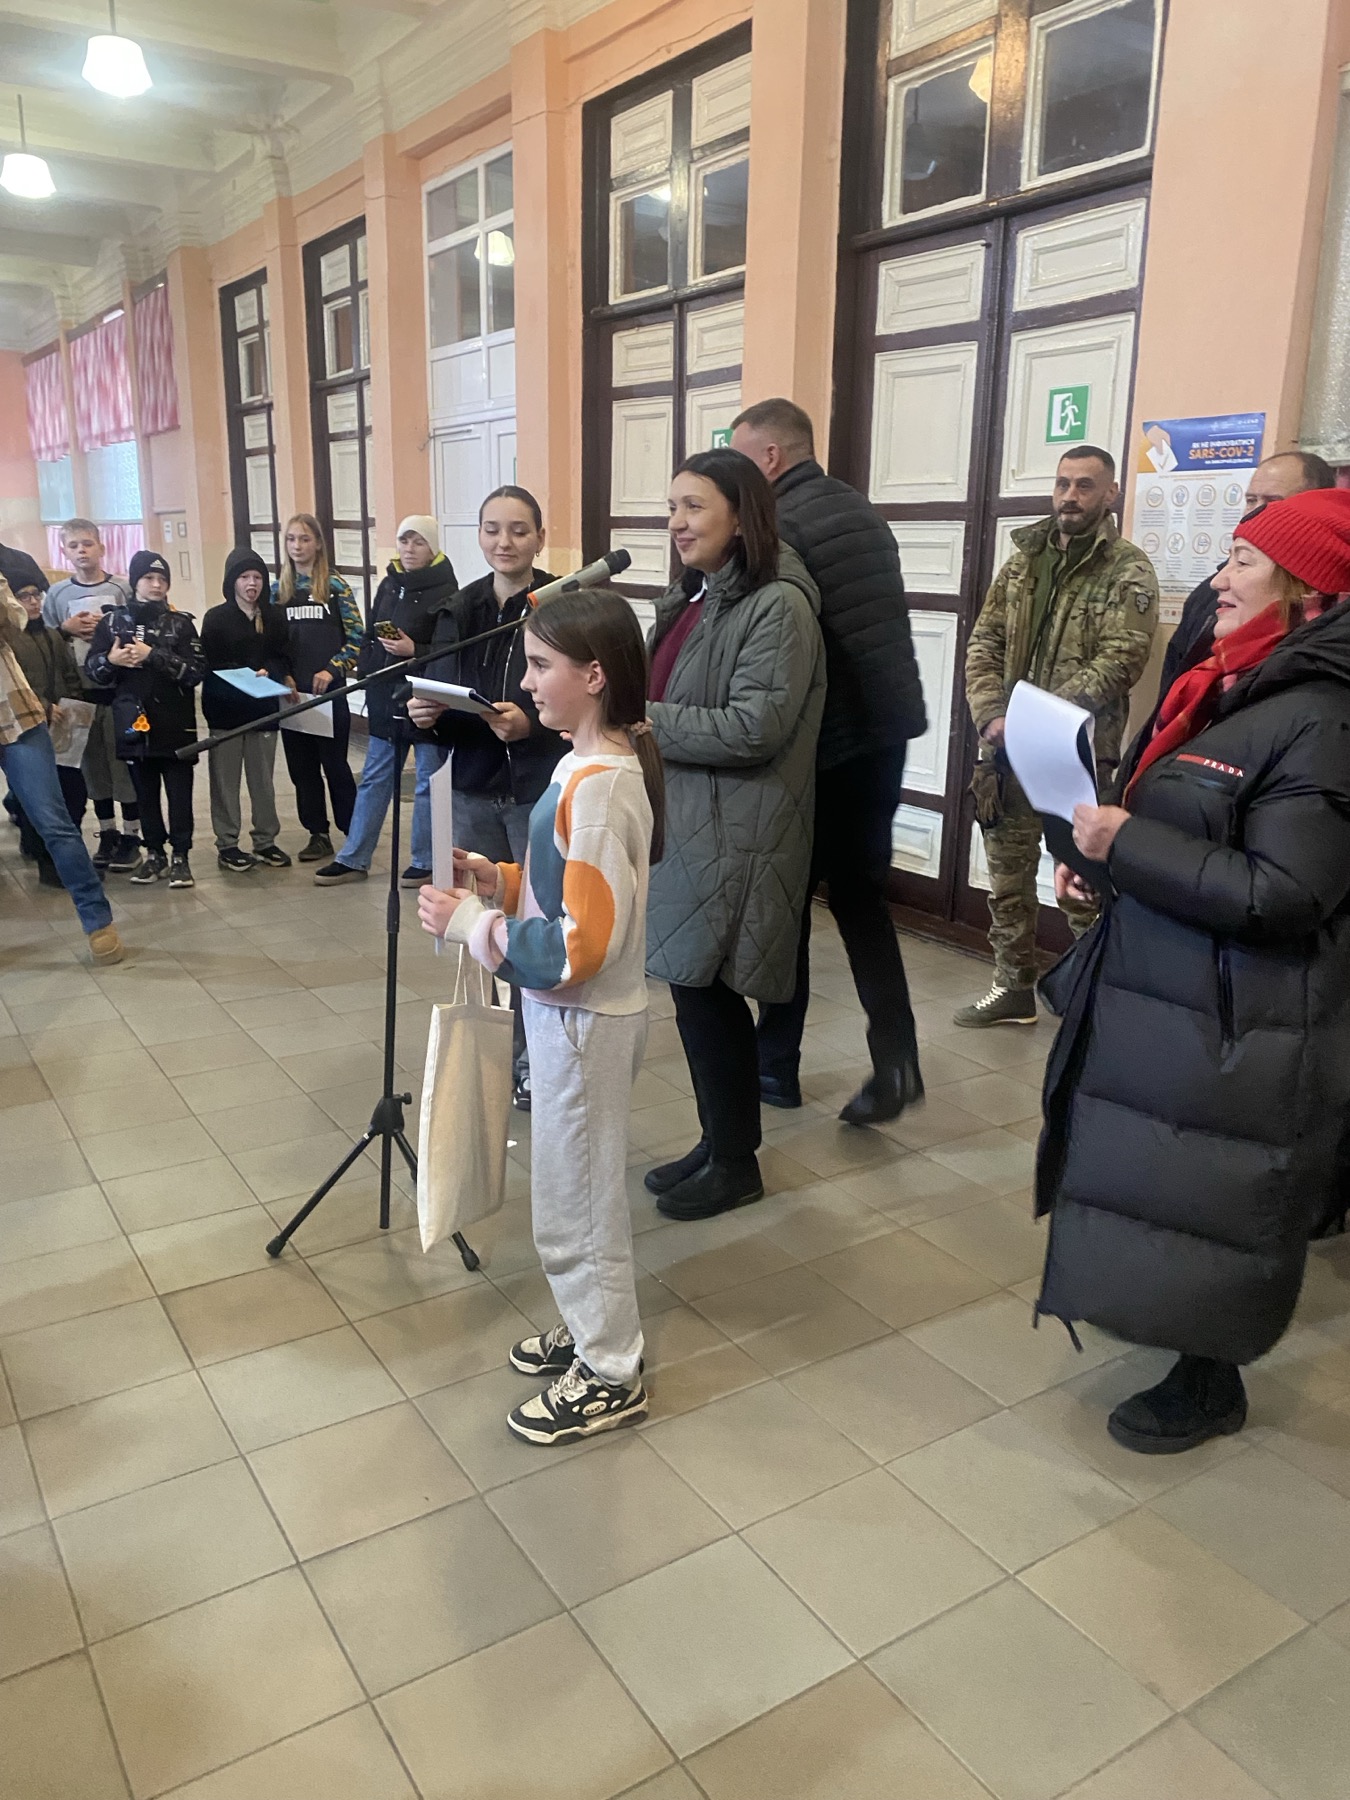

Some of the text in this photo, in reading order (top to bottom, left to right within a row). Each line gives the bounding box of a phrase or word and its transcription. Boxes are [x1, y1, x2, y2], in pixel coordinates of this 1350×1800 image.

[1188, 445, 1255, 460] SARS-COV-2
[286, 605, 323, 621] PUMA
[1203, 758, 1244, 777] PRADA
